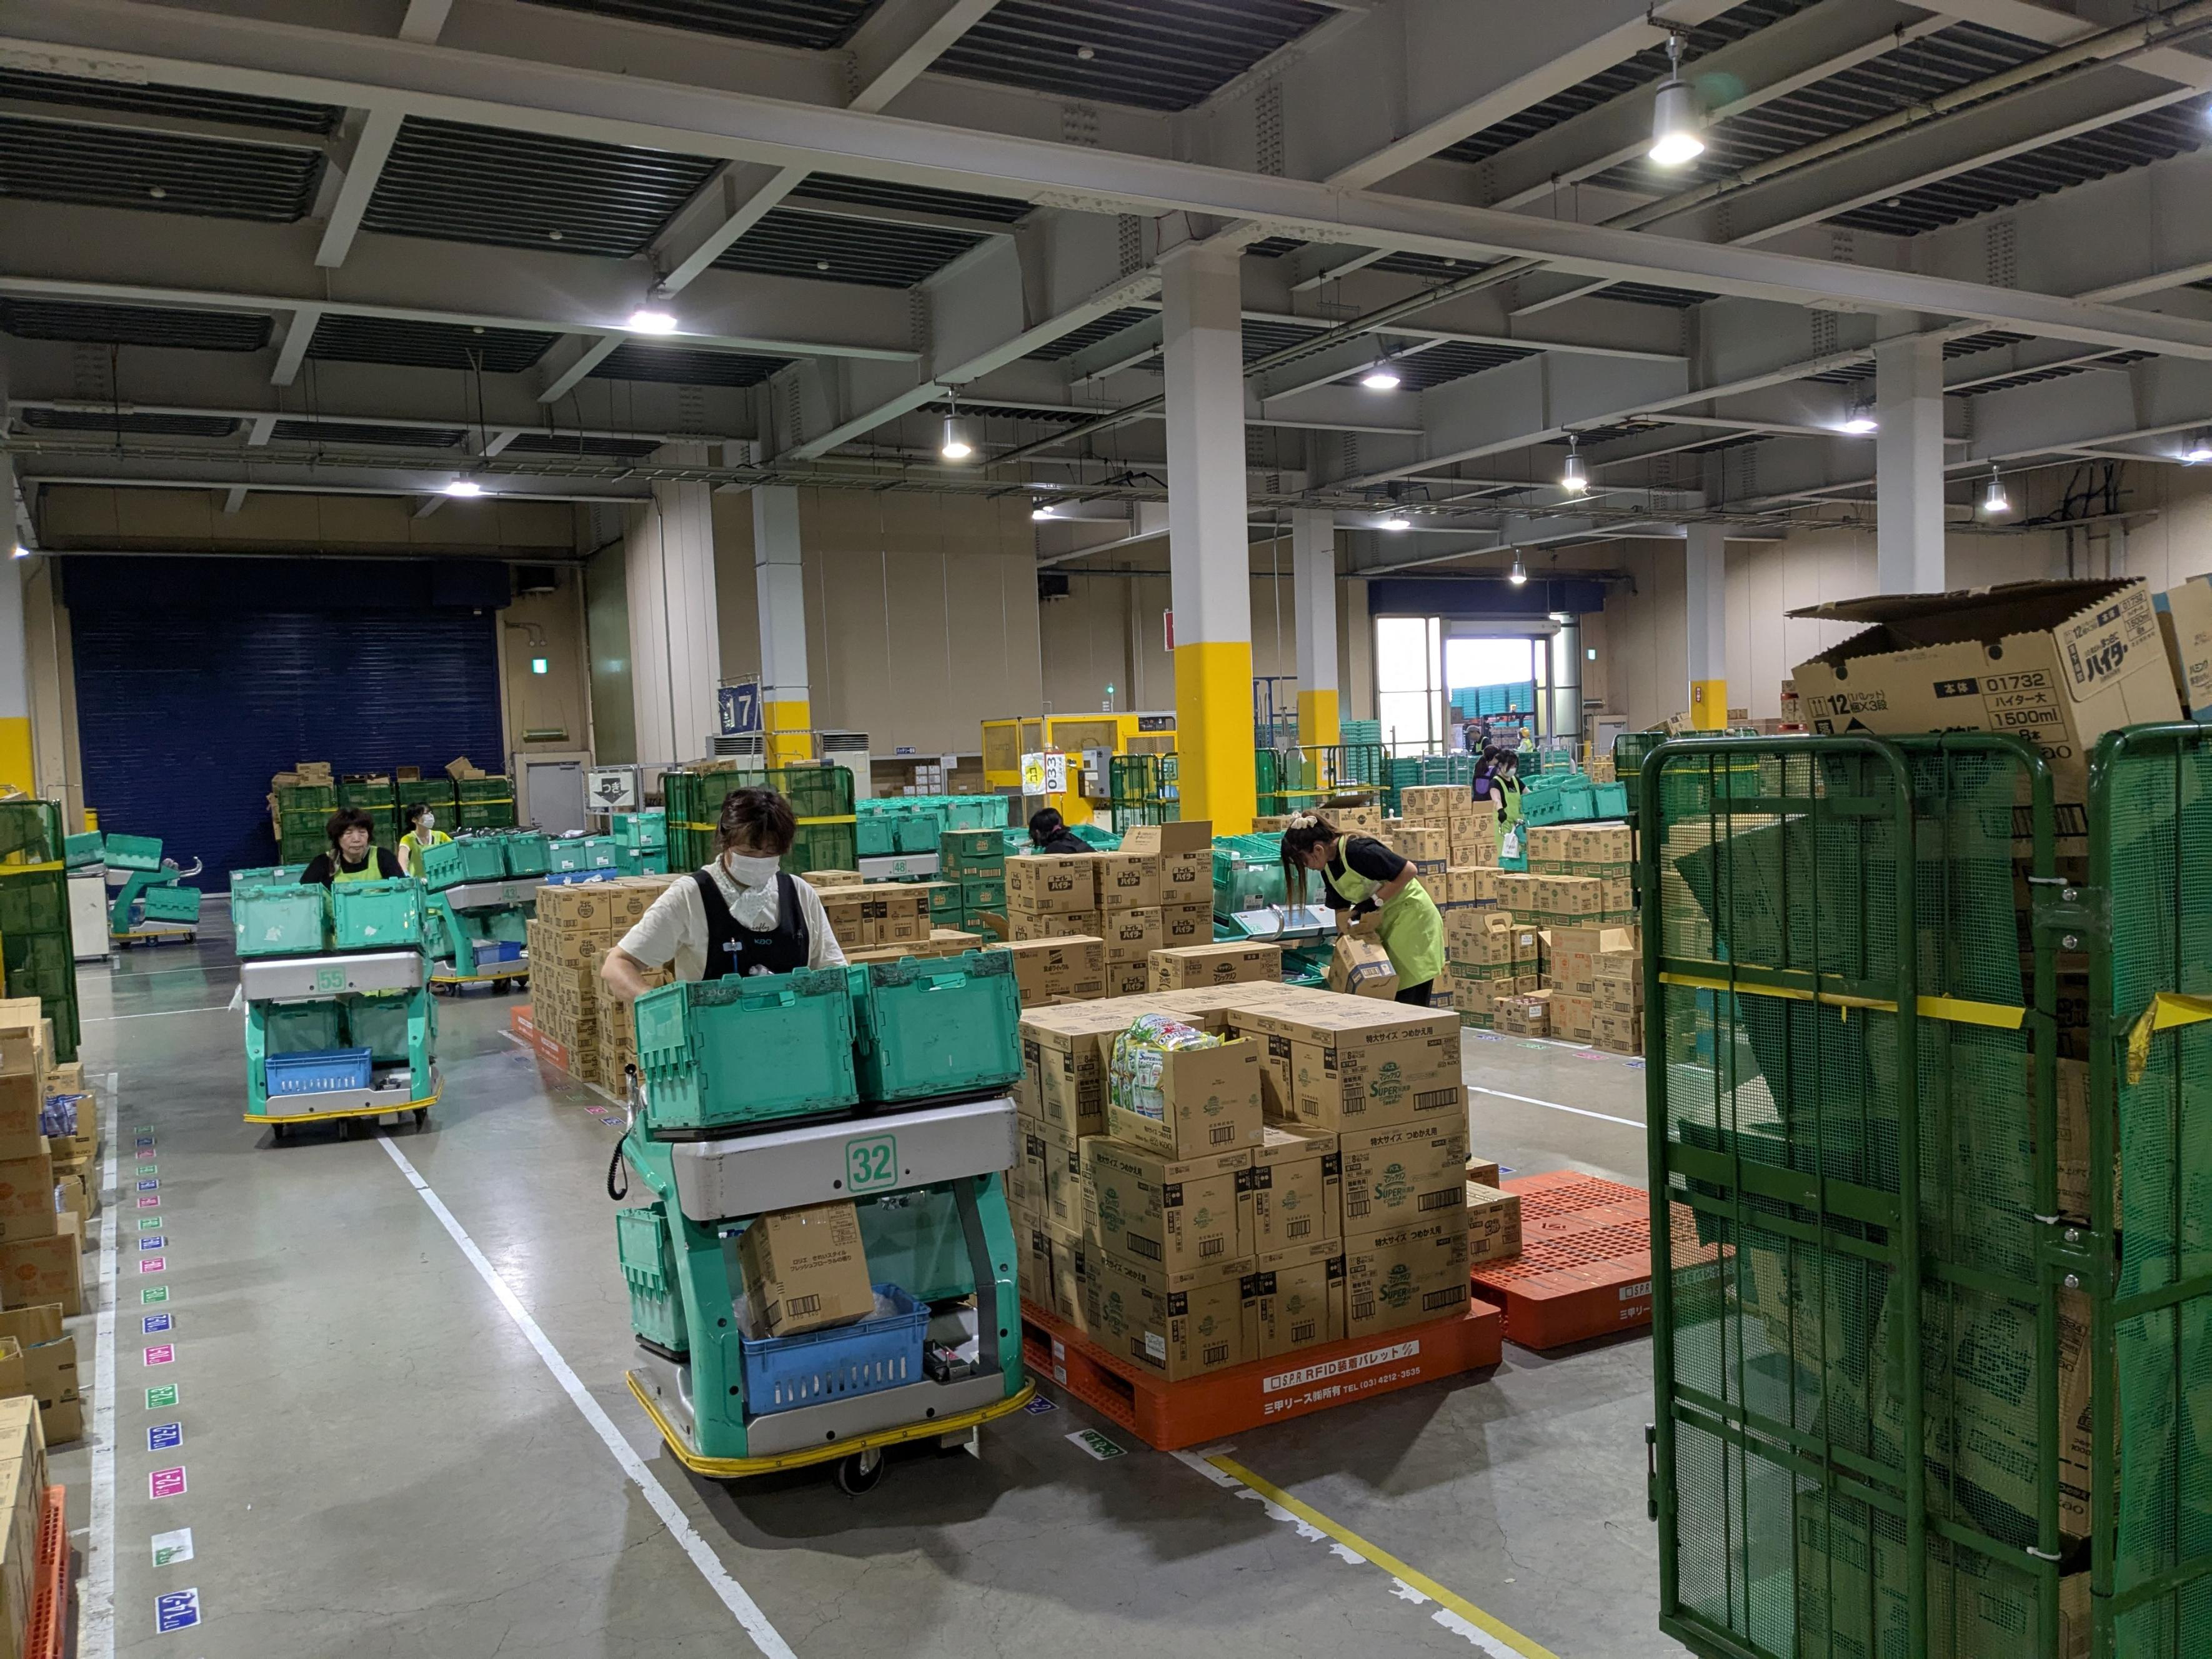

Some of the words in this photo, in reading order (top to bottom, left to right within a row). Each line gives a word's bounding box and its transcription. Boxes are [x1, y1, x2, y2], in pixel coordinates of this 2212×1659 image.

[1943, 681, 1968, 694] 本体
[1986, 674, 2046, 692] 01732
[1827, 694, 1851, 715] 12
[1995, 694, 2048, 707] ハイター大
[728, 694, 752, 727] 17
[1995, 707, 2058, 726] 1500ml
[1047, 756, 1057, 789] 033
[602, 782, 621, 794] つぎ
[895, 862, 905, 872] 48
[1120, 877, 1138, 885] ハイター
[1175, 873, 1193, 881] ハイター
[1052, 882, 1071, 890] ハイター
[1123, 930, 1141, 939] ハイター
[1175, 925, 1193, 934] ハイター
[320, 971, 342, 989] 55
[1213, 972, 1237, 982] マジックリン
[1366, 1031, 1398, 1044] 特大サイズ
[1402, 1027, 1433, 1039] つめかえ用
[1370, 1133, 1402, 1146] 特大サイズ
[1406, 1127, 1437, 1139] つめかえ用
[1159, 1140, 1172, 1150] Kao
[852, 1145, 892, 1183] 32
[1375, 1234, 1407, 1247] 特大サイズ
[1410, 1225, 1442, 1238] つめかえ用
[790, 1255, 852, 1272] フレッシュフローラルの香り
[812, 1250, 847, 1261] きれいスタイル
[147, 1315, 166, 1328] 10-2
[148, 1346, 169, 1360] 10-1
[1305, 1347, 1399, 1381] RFID装着パレット
[1343, 1385, 1358, 1393] TEL
[1360, 1378, 1377, 1389] (03)
[1378, 1367, 1421, 1384] 4212-3535
[149, 1386, 173, 1402] 12-3
[152, 1424, 177, 1443] 12-2
[155, 1469, 181, 1489] 12-1
[162, 1592, 193, 1620] 14-2
[163, 1620, 180, 1629] 17
